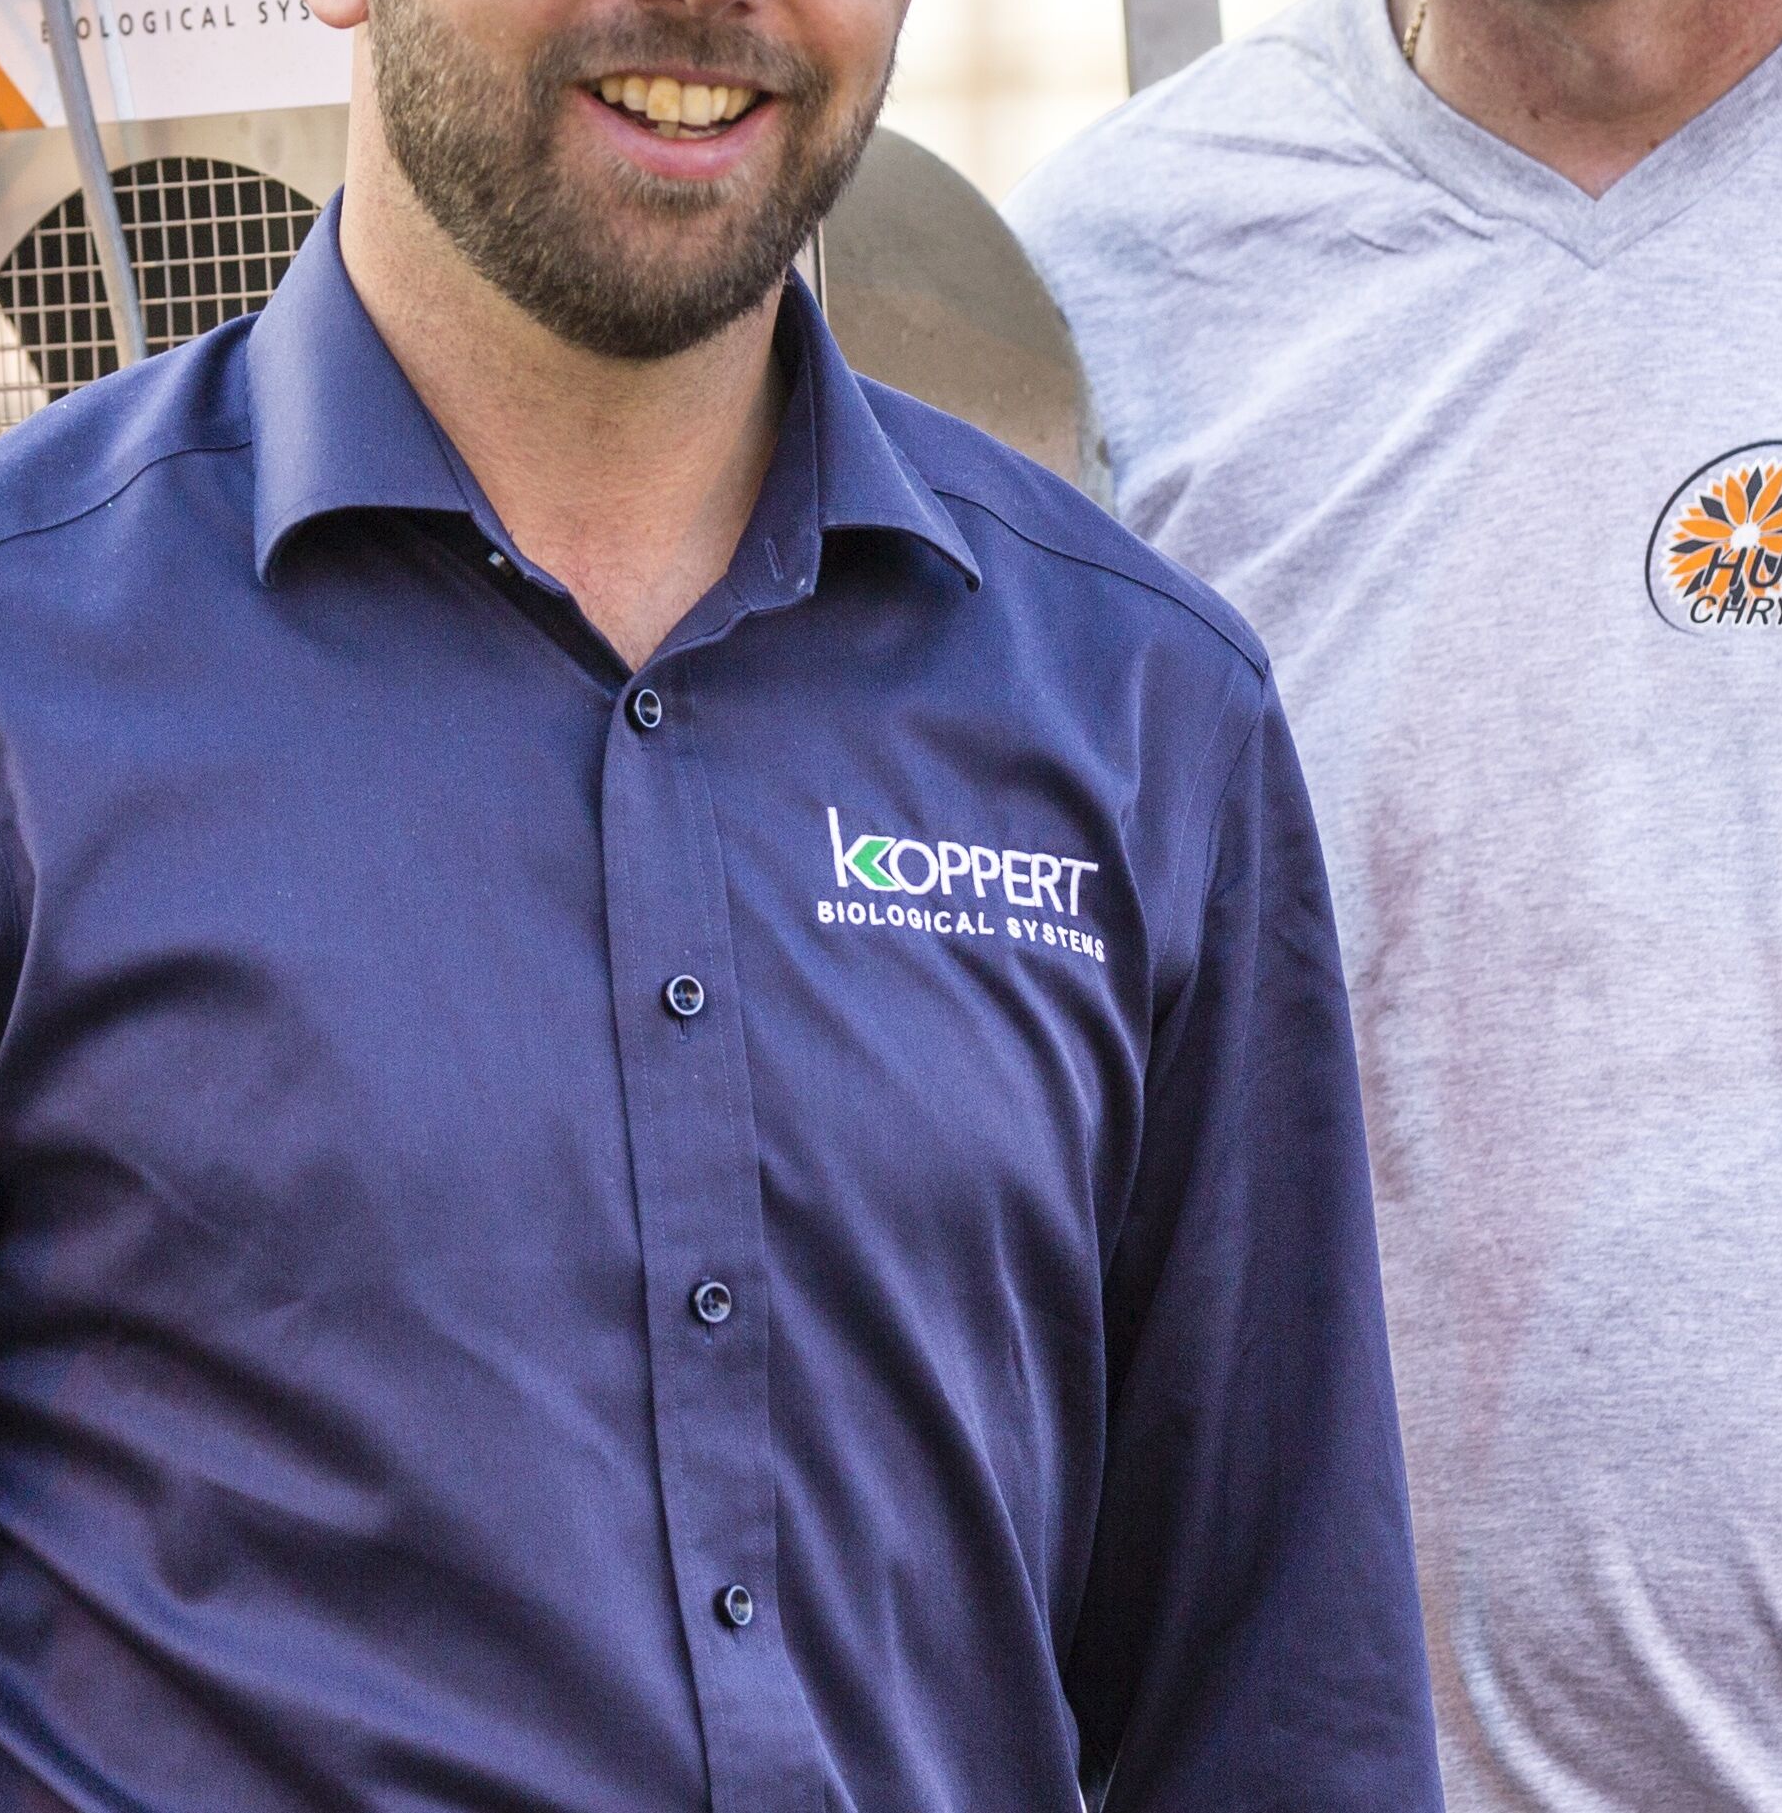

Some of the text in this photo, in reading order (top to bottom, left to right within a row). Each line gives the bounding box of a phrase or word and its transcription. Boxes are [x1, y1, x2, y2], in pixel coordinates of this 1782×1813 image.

[42, 4, 236, 43] BOLOGICAL
[827, 806, 1099, 916] KOPPERT
[818, 901, 1106, 963] BIOLOGICAL SYSTEMS
